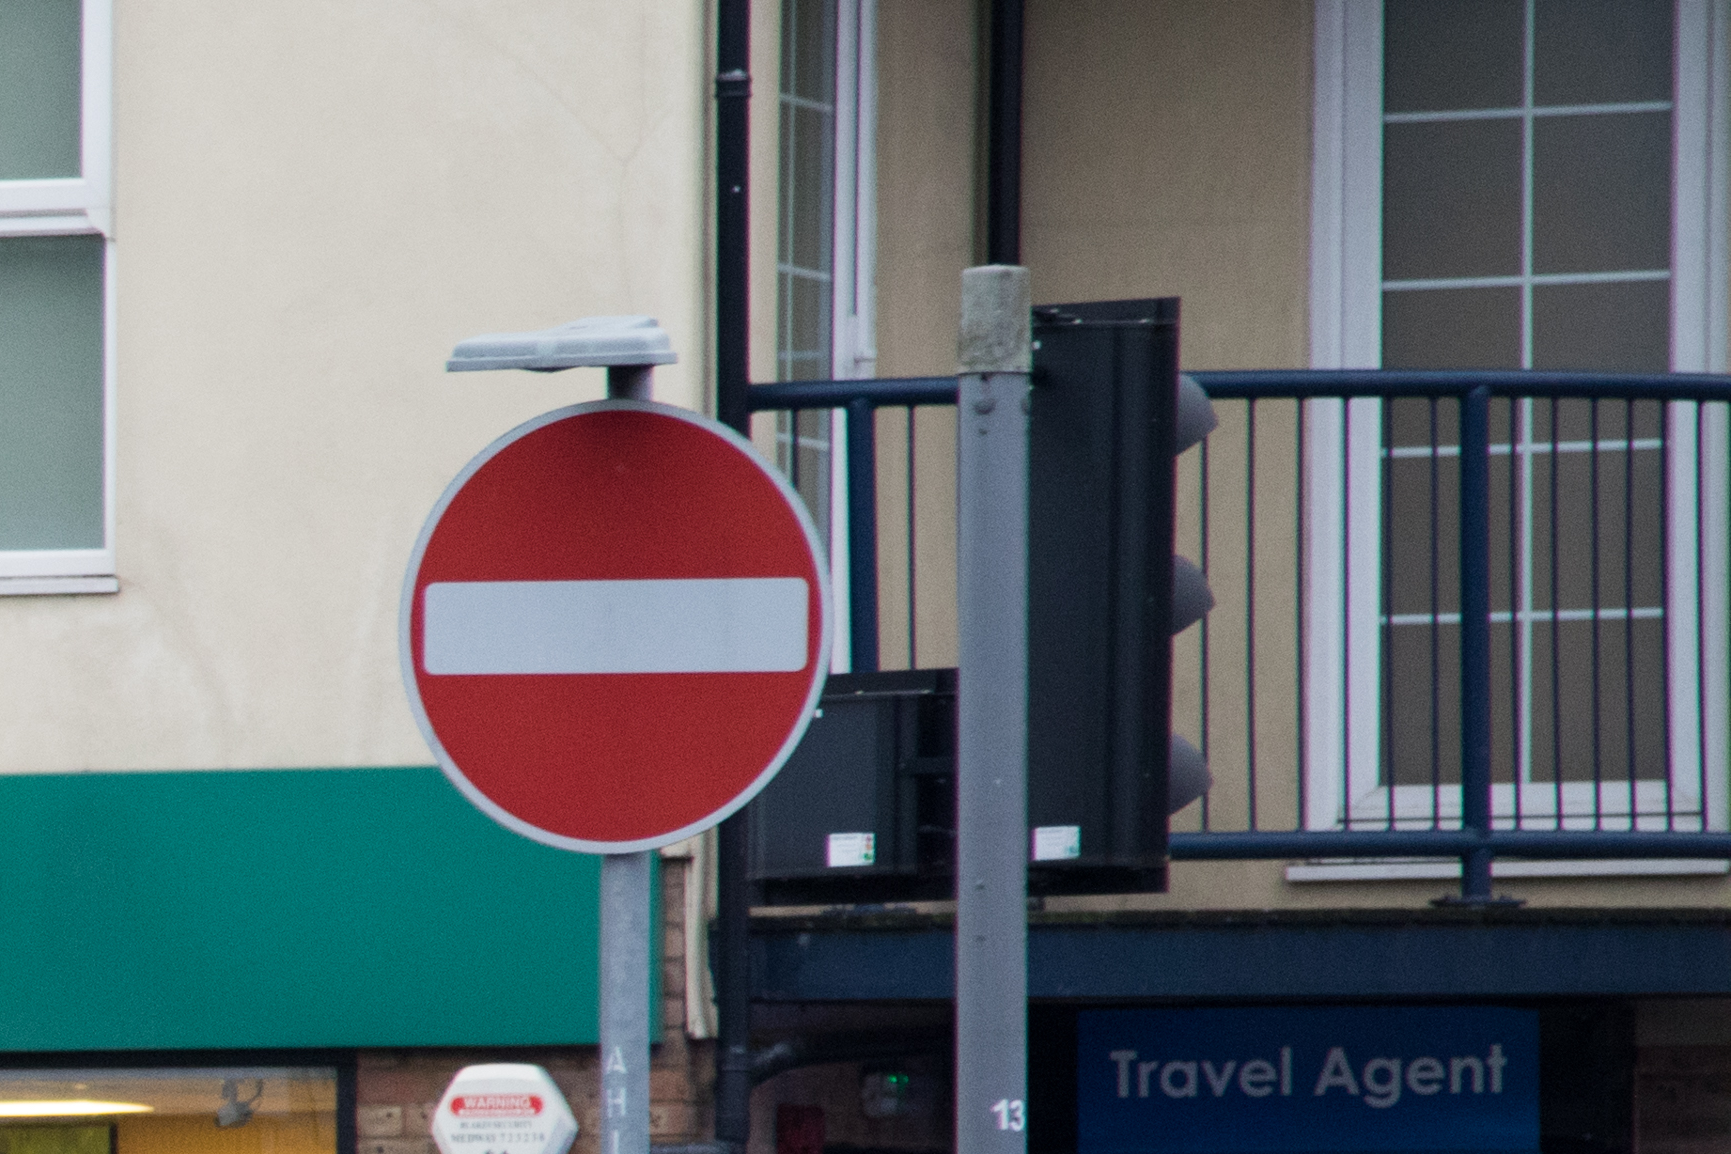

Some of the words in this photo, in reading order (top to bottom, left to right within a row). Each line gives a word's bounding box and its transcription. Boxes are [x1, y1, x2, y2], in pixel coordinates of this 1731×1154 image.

[1109, 1046, 1293, 1098] Travel
[1314, 1043, 1508, 1108] Agent
[990, 1098, 1026, 1132] 13
